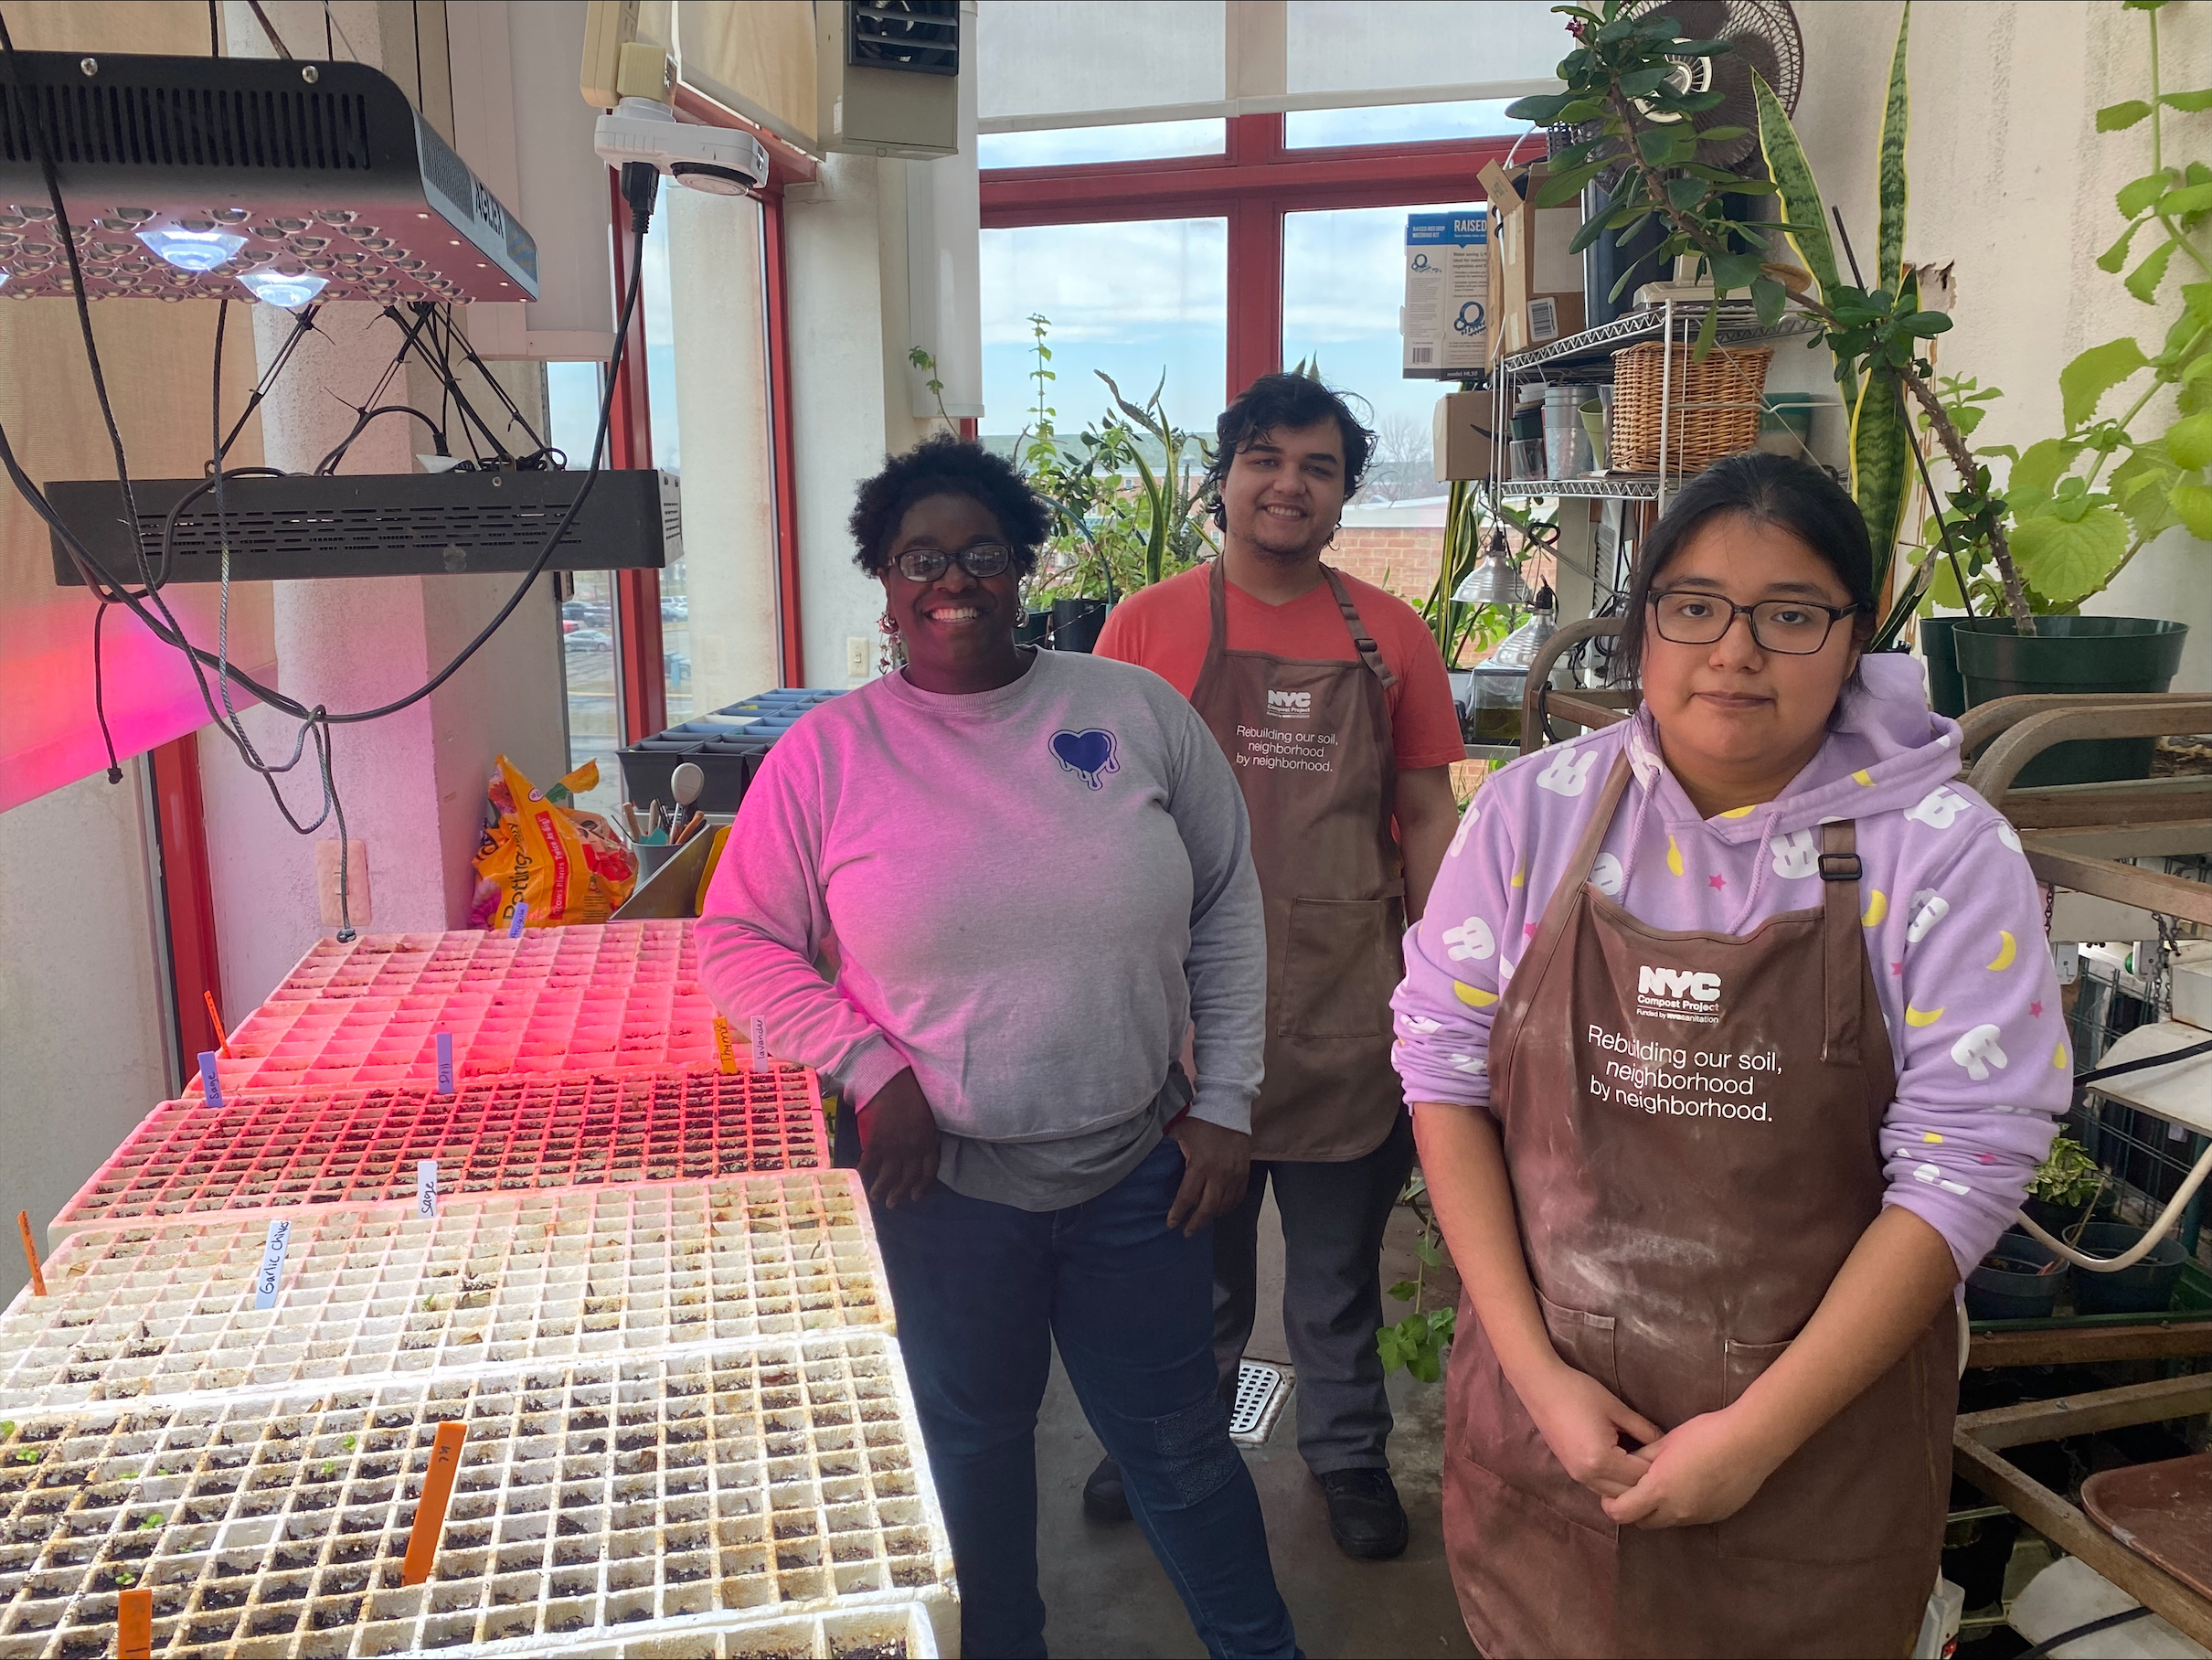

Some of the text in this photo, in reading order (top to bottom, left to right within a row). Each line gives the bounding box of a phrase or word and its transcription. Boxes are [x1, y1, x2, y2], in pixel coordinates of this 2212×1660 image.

[1453, 219, 1486, 232] RAISED
[1268, 689, 1312, 708] NYC
[1236, 724, 1338, 746] Rebuilding our soil,
[1248, 740, 1324, 758] neighborhood
[1236, 752, 1333, 772] by neighborhood.
[551, 841, 563, 861] Twice
[556, 862, 565, 888] Plants
[510, 909, 525, 939] Arugula
[1638, 965, 1721, 1002] NYC
[1636, 1007, 1659, 1017] Funded
[1658, 1011, 1666, 1019] by
[1637, 995, 1719, 1013] Compost Project
[1588, 1024, 1782, 1075] Rebuilding our soil,
[439, 1063, 451, 1083] Dill
[1606, 1059, 1754, 1095] neighborhood
[208, 1071, 219, 1100] Sage
[1590, 1075, 1773, 1123] by neighborhood.
[421, 1181, 437, 1217] Sage
[259, 1255, 280, 1294] Garlic
